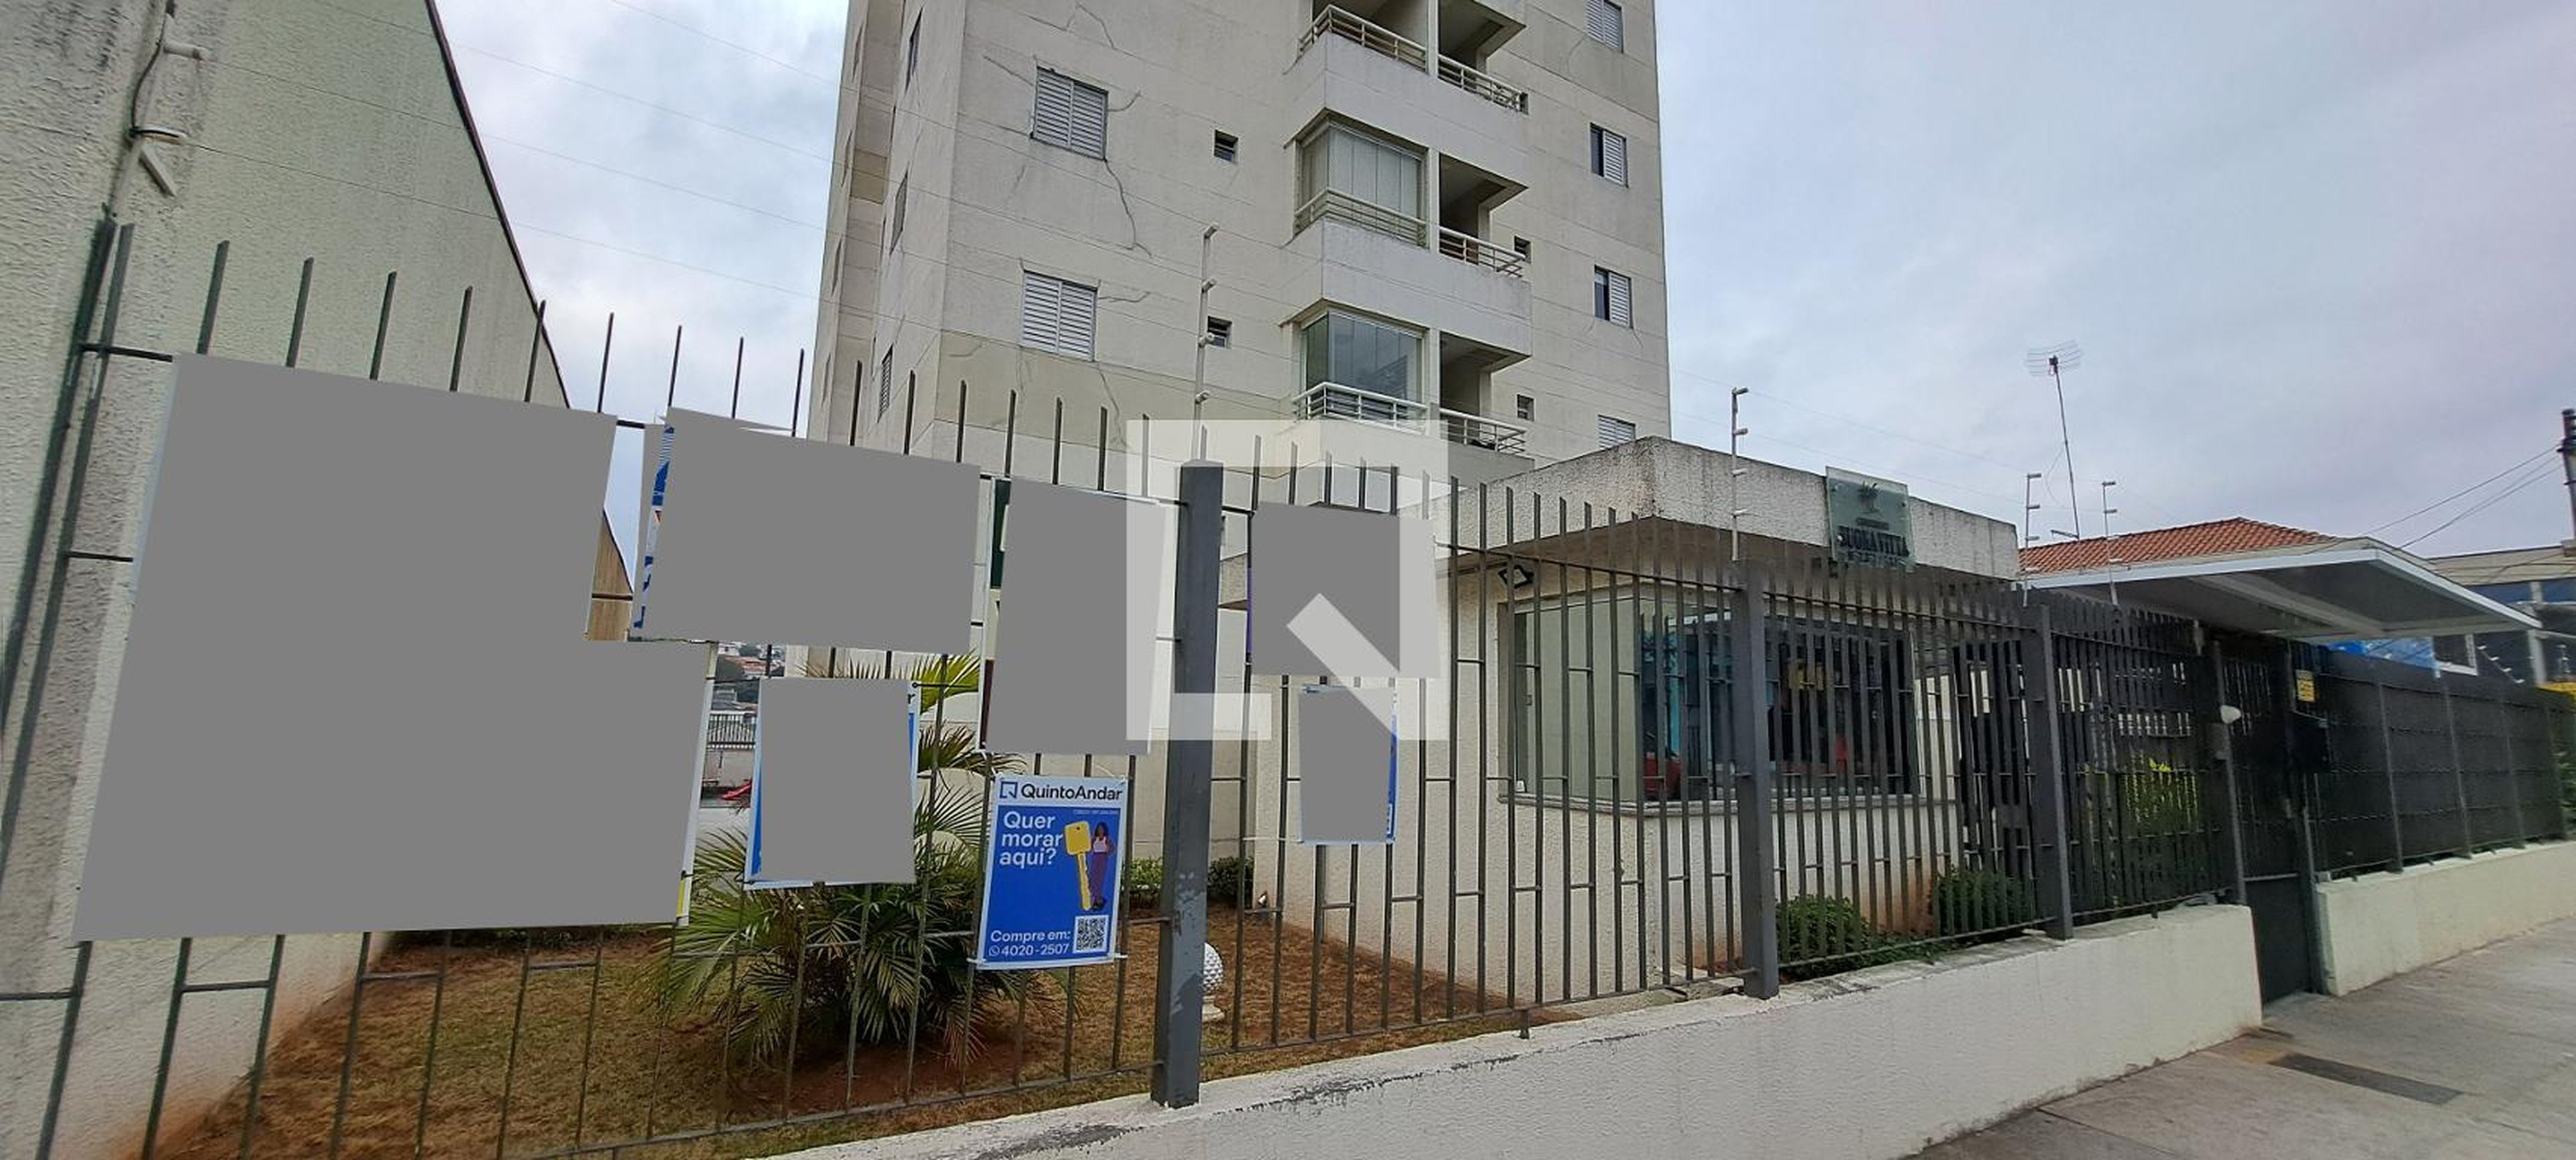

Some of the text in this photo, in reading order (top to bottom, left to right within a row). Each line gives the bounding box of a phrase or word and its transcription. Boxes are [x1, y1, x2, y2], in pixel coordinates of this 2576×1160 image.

[1020, 783, 1123, 800] QuintoAndar
[1004, 810, 1056, 829] Quer
[1002, 833, 1063, 847] morar
[999, 847, 1057, 869] aqui?
[990, 930, 1071, 944] Compre em:
